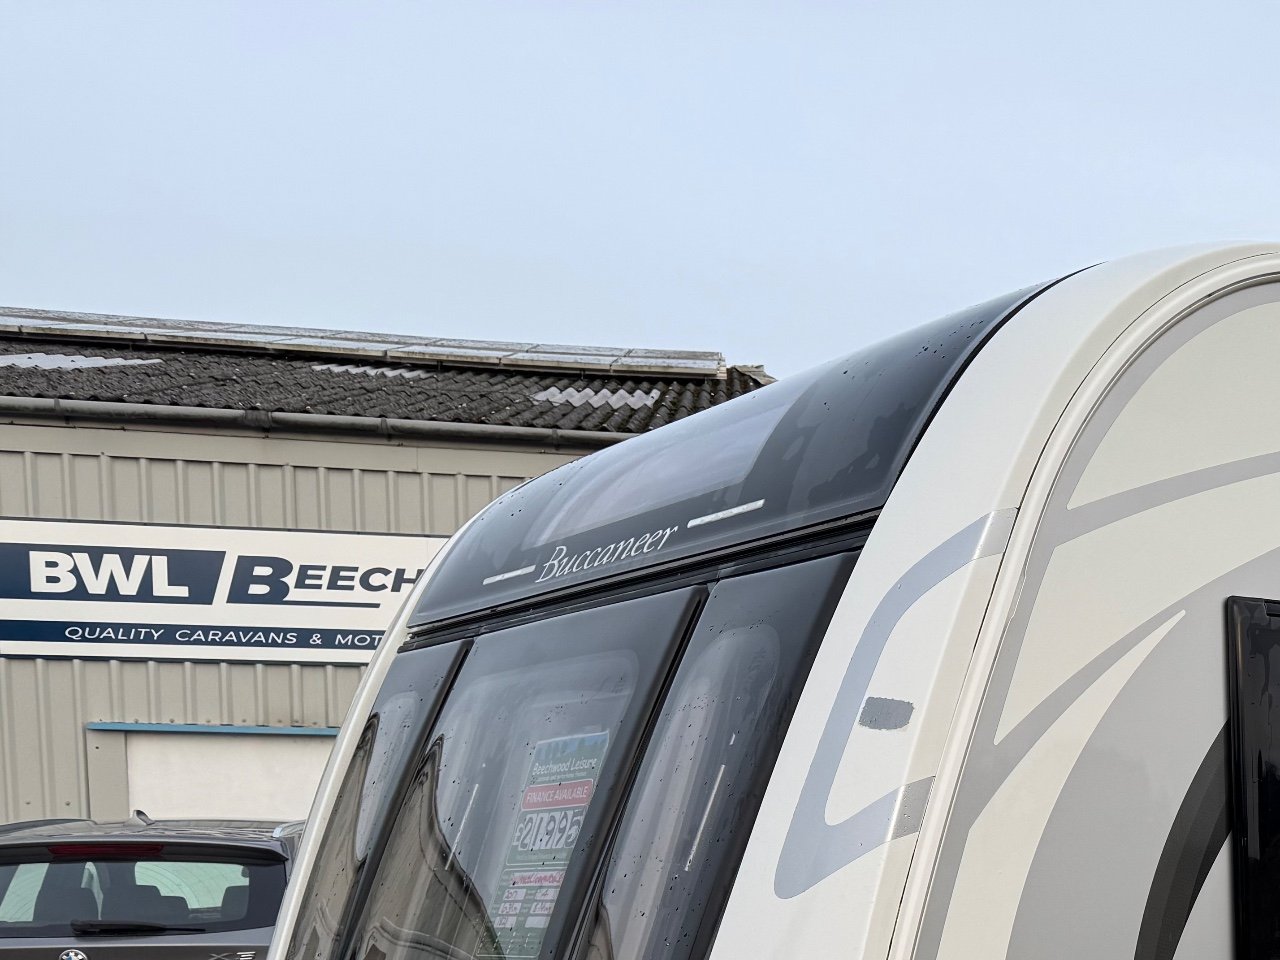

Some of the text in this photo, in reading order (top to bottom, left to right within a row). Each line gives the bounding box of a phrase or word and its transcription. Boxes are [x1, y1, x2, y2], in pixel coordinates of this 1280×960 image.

[535, 525, 679, 583] Buccaneer
[28, 550, 189, 598] BWL
[64, 626, 165, 642] QUALITY
[175, 629, 297, 645] CARAVANS
[309, 633, 323, 645] &
[532, 758, 572, 776] Beechwood
[571, 756, 597, 771] Leisure
[527, 786, 588, 803] FINANCE AVAILABLE
